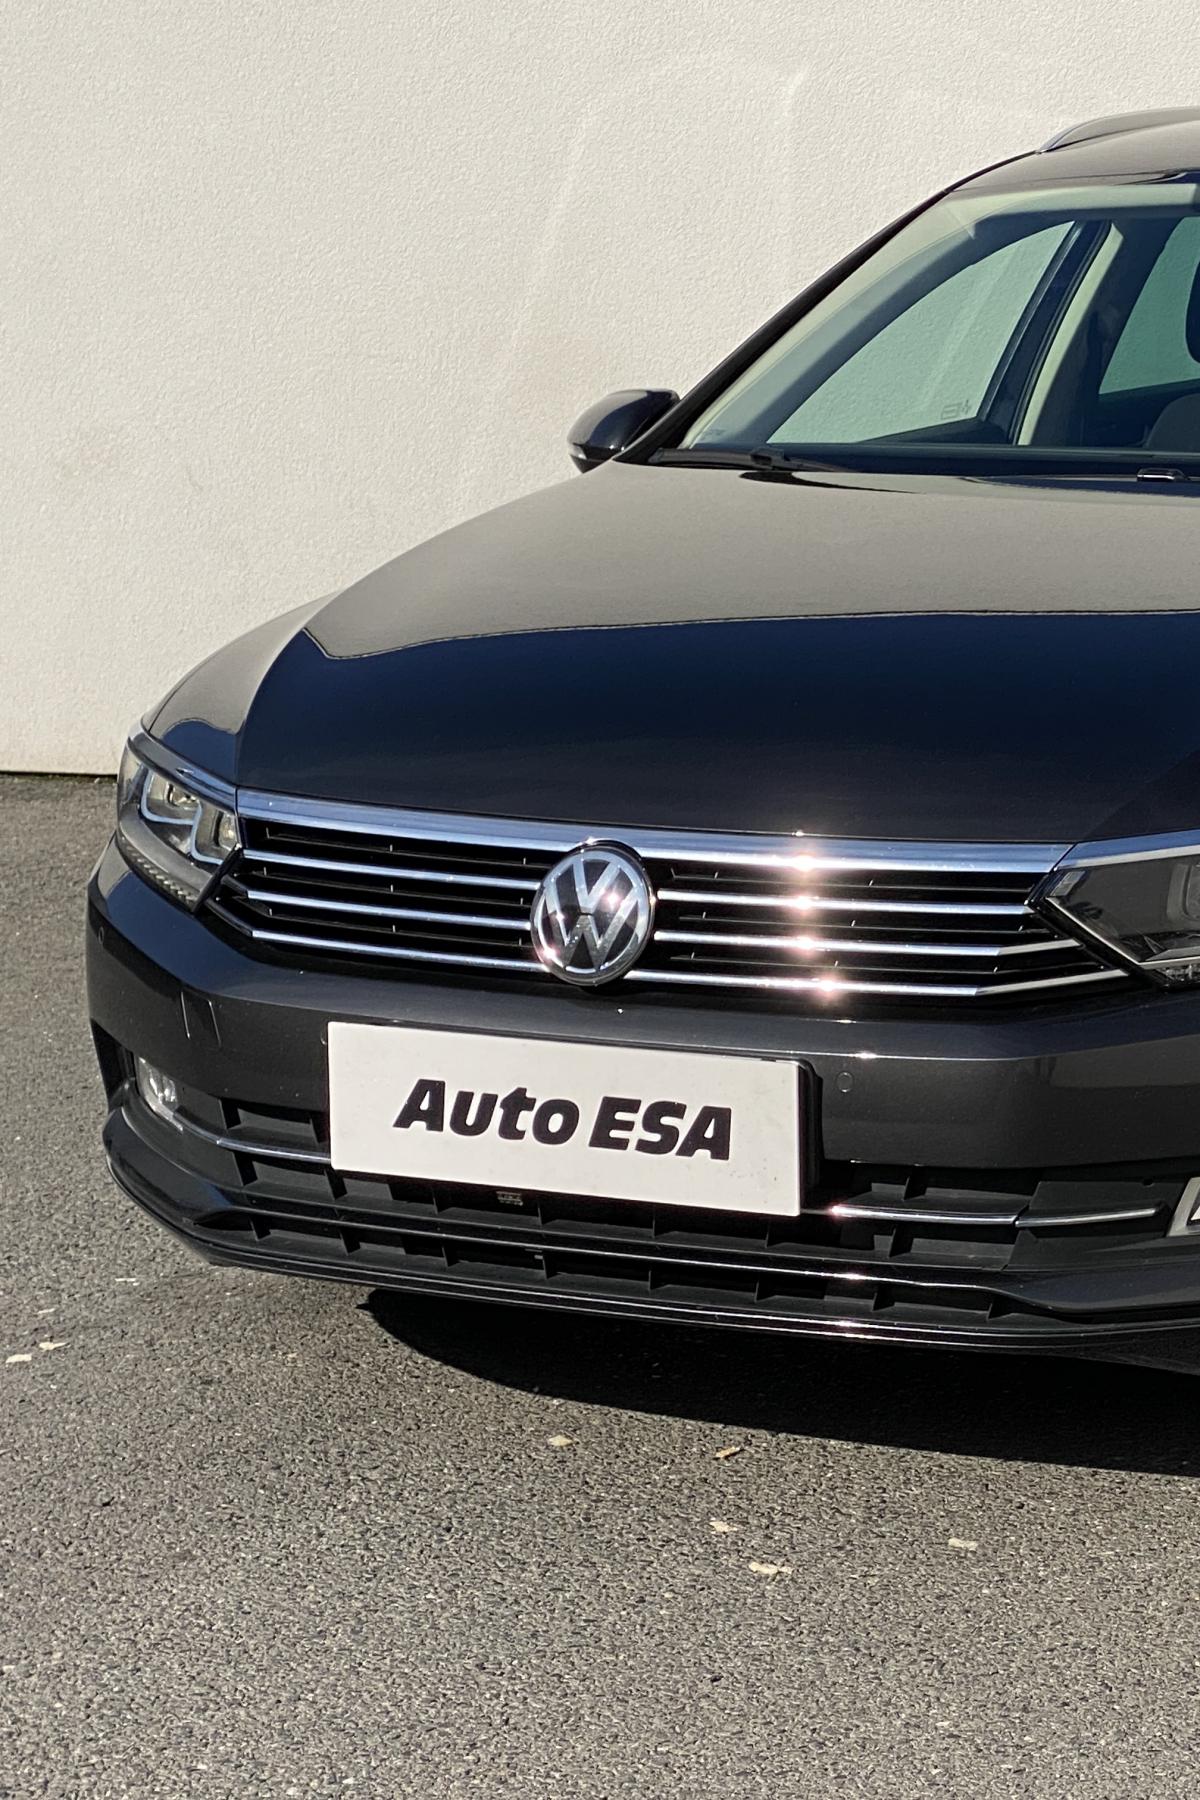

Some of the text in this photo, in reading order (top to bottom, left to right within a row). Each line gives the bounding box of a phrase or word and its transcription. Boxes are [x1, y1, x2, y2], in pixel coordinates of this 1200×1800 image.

[532, 845, 653, 980] VW
[392, 1078, 732, 1161] Auto ESA
